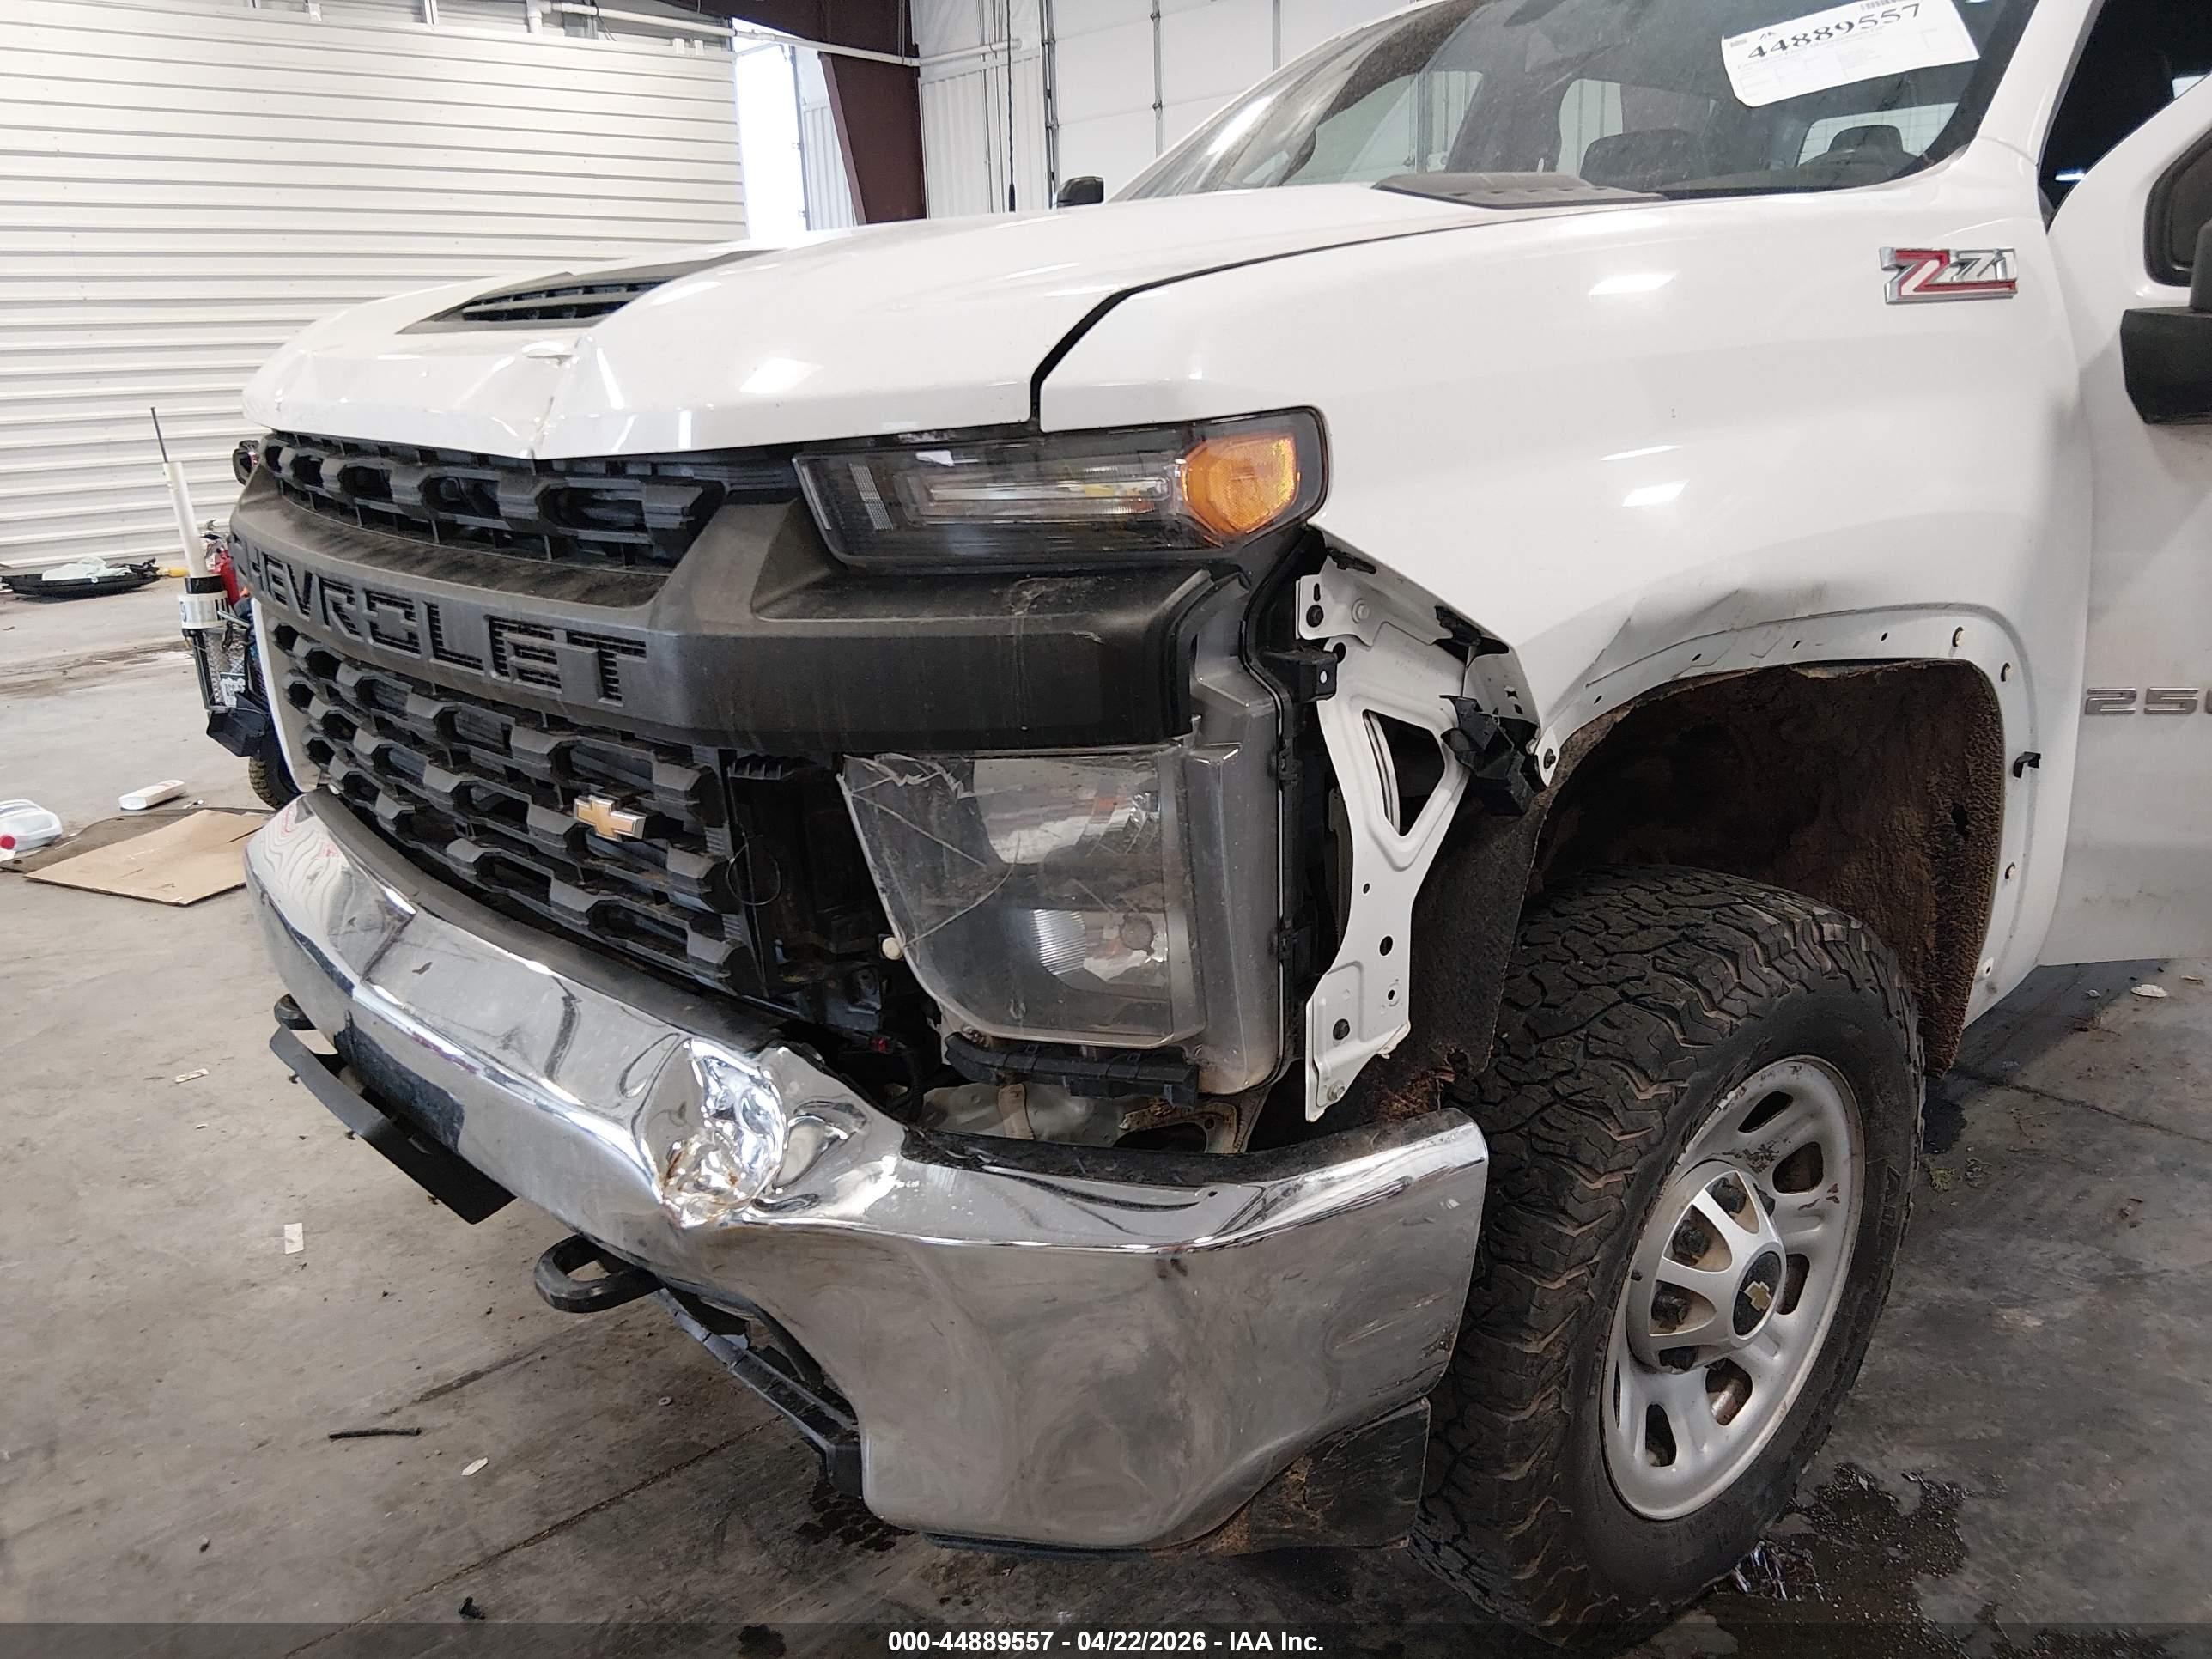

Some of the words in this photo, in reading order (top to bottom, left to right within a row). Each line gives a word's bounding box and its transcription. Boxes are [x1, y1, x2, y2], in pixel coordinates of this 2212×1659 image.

[1748, 3, 1920, 58] 44889557
[1879, 246, 2018, 305] Z71
[2085, 686, 2212, 715] 25
